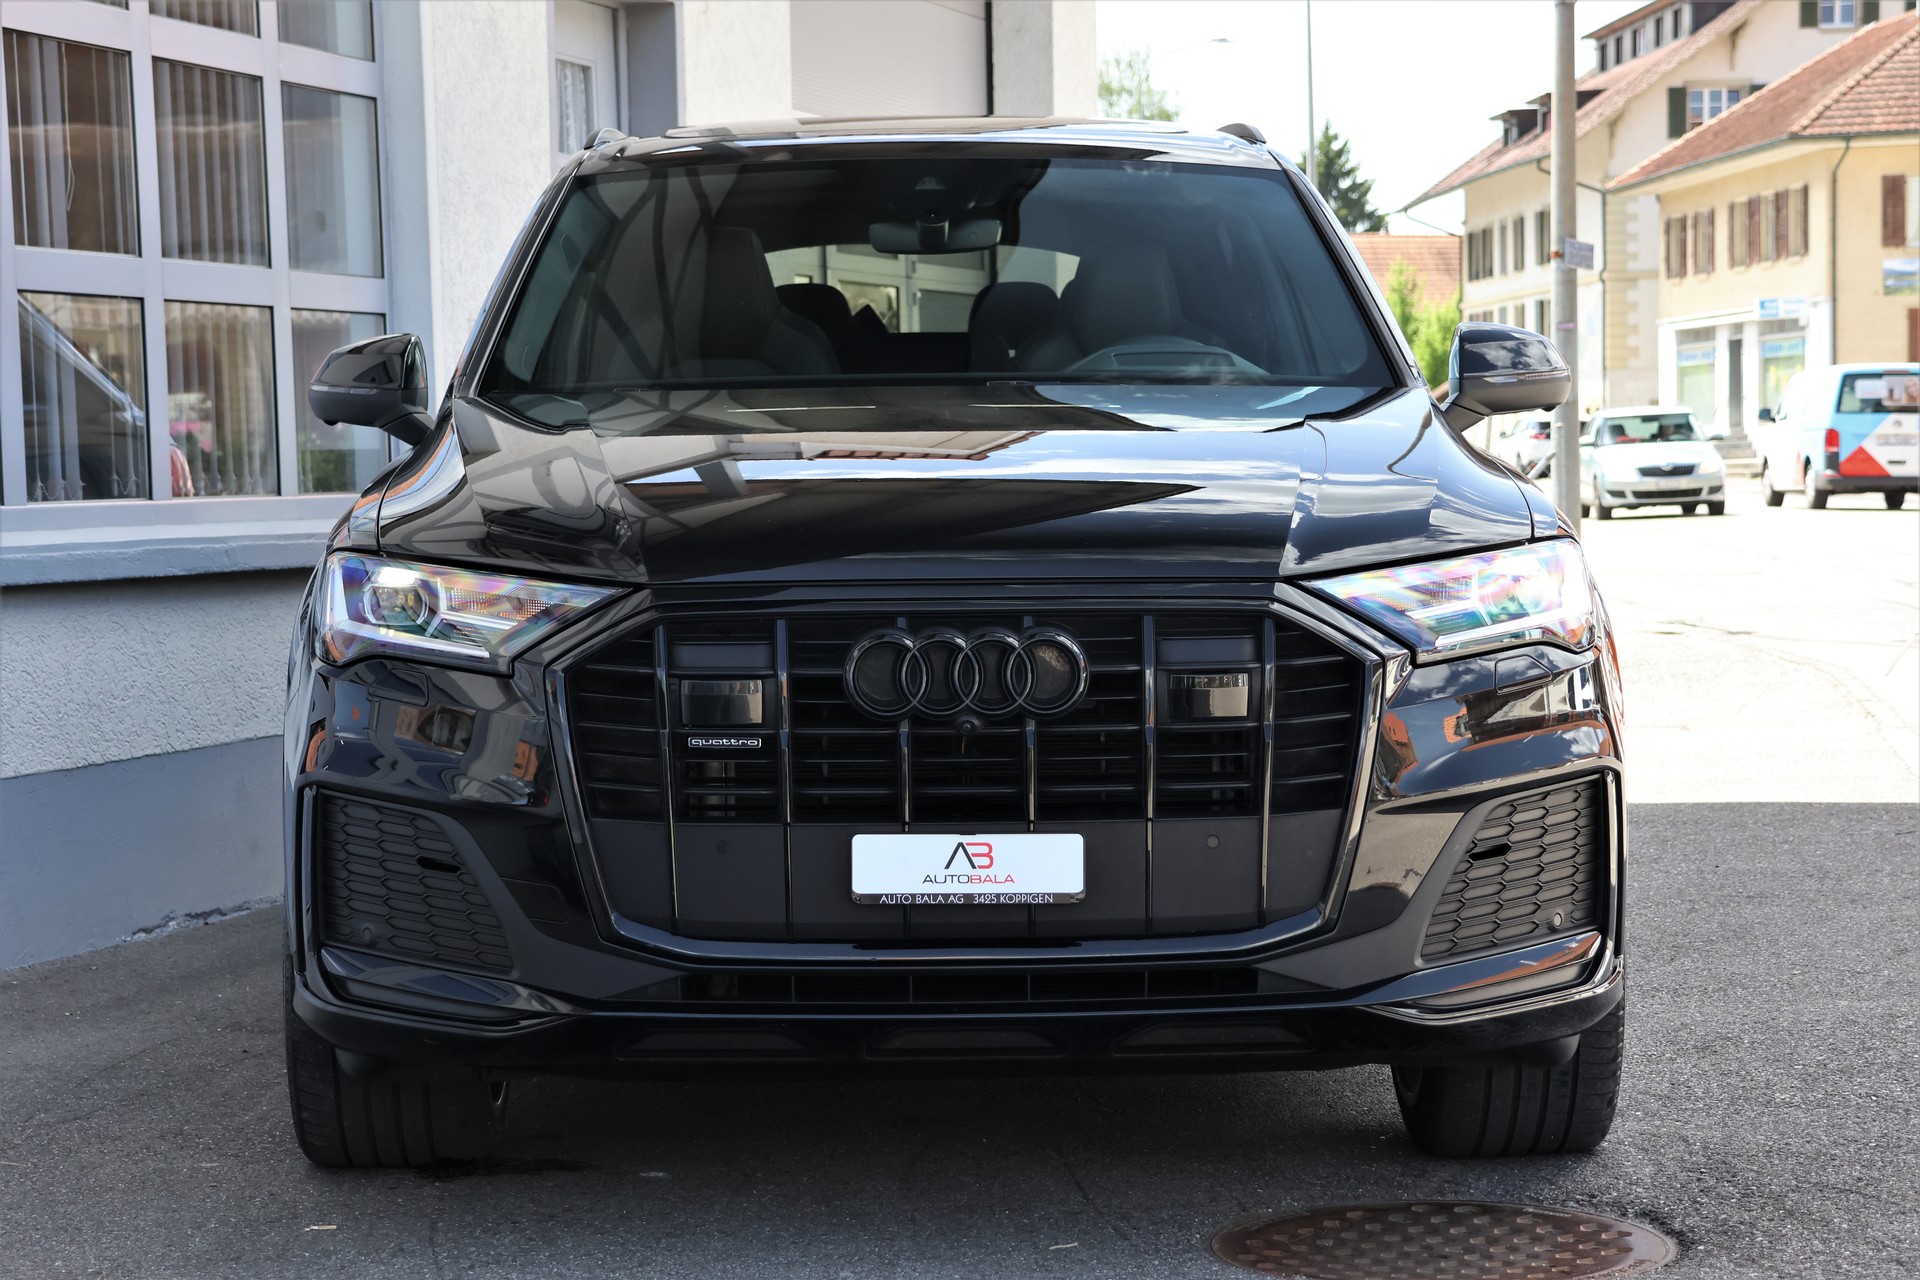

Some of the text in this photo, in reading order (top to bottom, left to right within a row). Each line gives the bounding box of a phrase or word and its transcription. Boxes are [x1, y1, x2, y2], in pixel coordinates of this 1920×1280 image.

[691, 738, 758, 746] quattro
[922, 875, 1015, 884] AUTOBALA
[880, 894, 1054, 904] AUTO BALA AG 3425 KOPPIGEN
